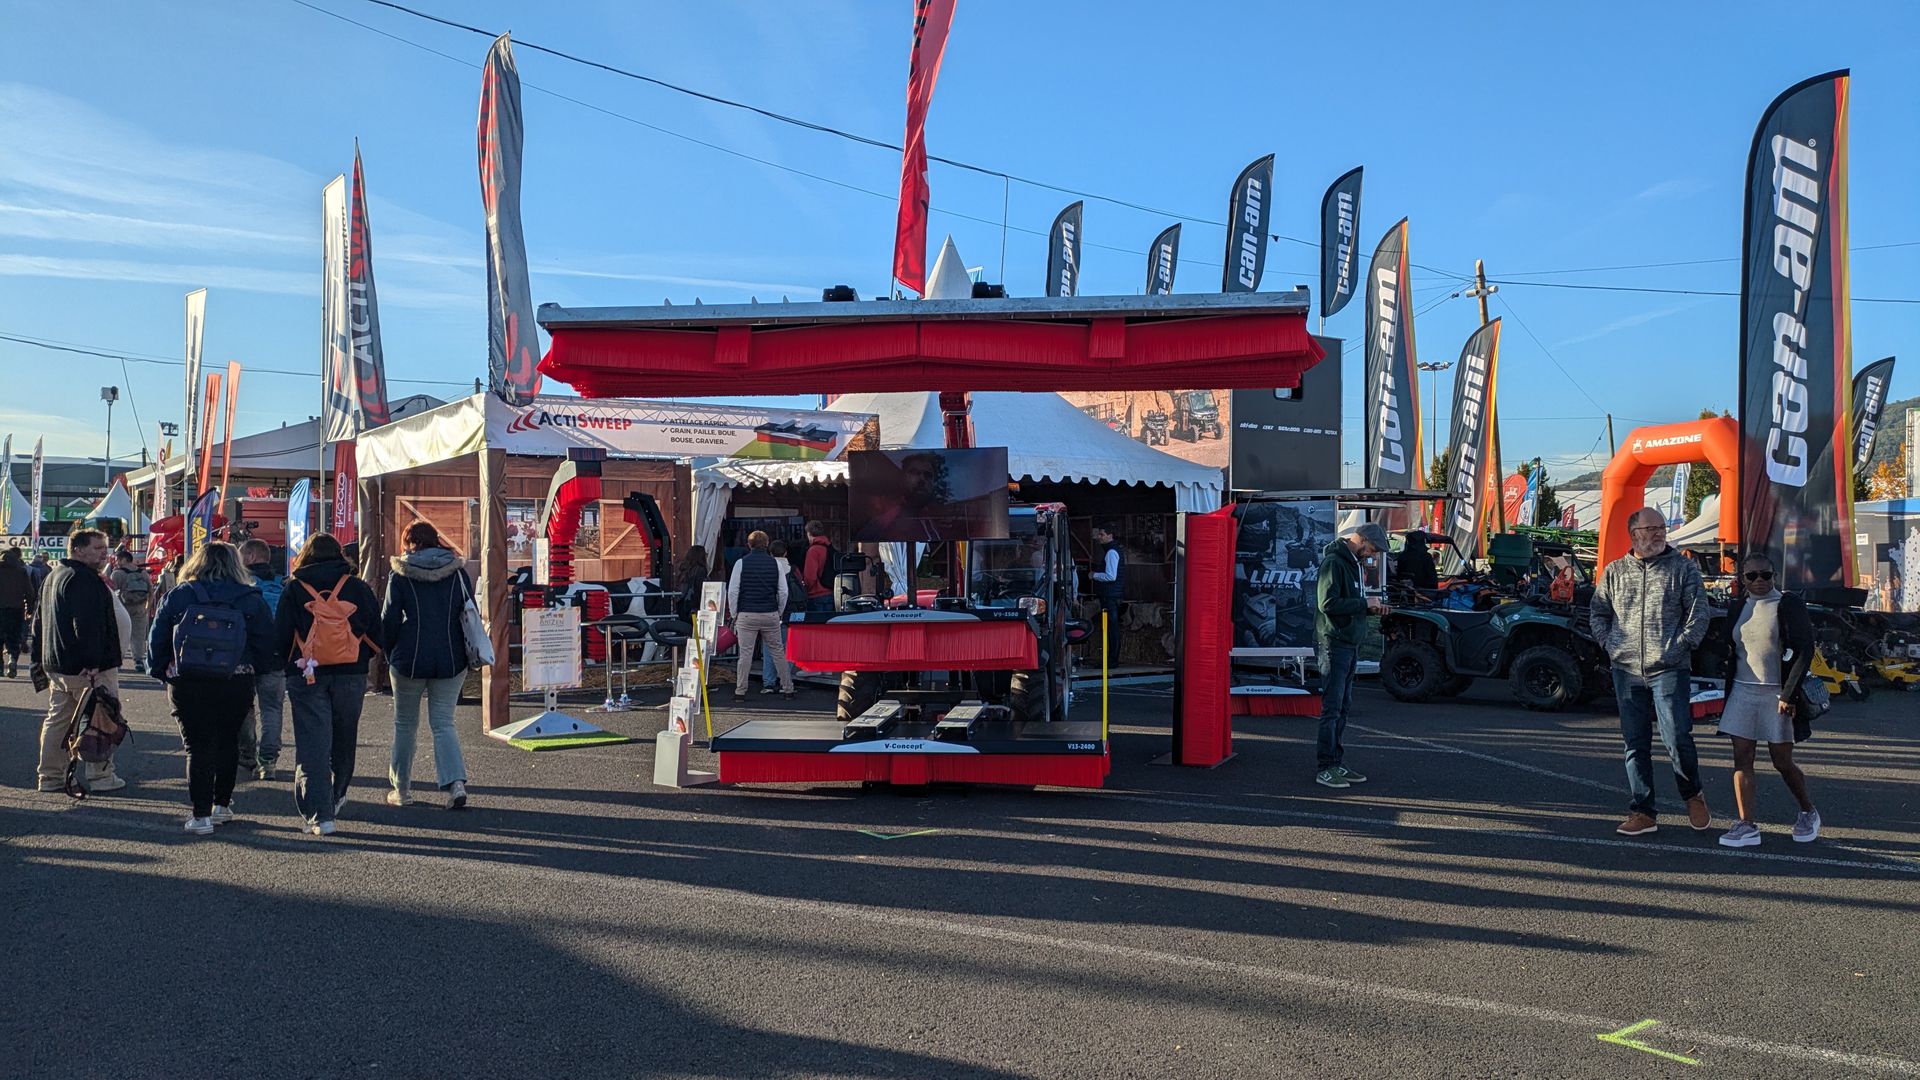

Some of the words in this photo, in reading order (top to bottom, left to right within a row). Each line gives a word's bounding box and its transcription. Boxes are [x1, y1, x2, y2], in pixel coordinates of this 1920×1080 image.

[1061, 221, 1075, 297] an-am
[1239, 177, 1262, 289] can-am
[1337, 191, 1353, 295] can-am
[1766, 133, 1819, 487] can-am
[1377, 267, 1406, 475] can-am
[670, 427, 692, 435] GRAIN,
[1455, 353, 1486, 533] can-am
[1645, 433, 1703, 449] AMAZONE
[8, 536, 64, 547] GAAGE
